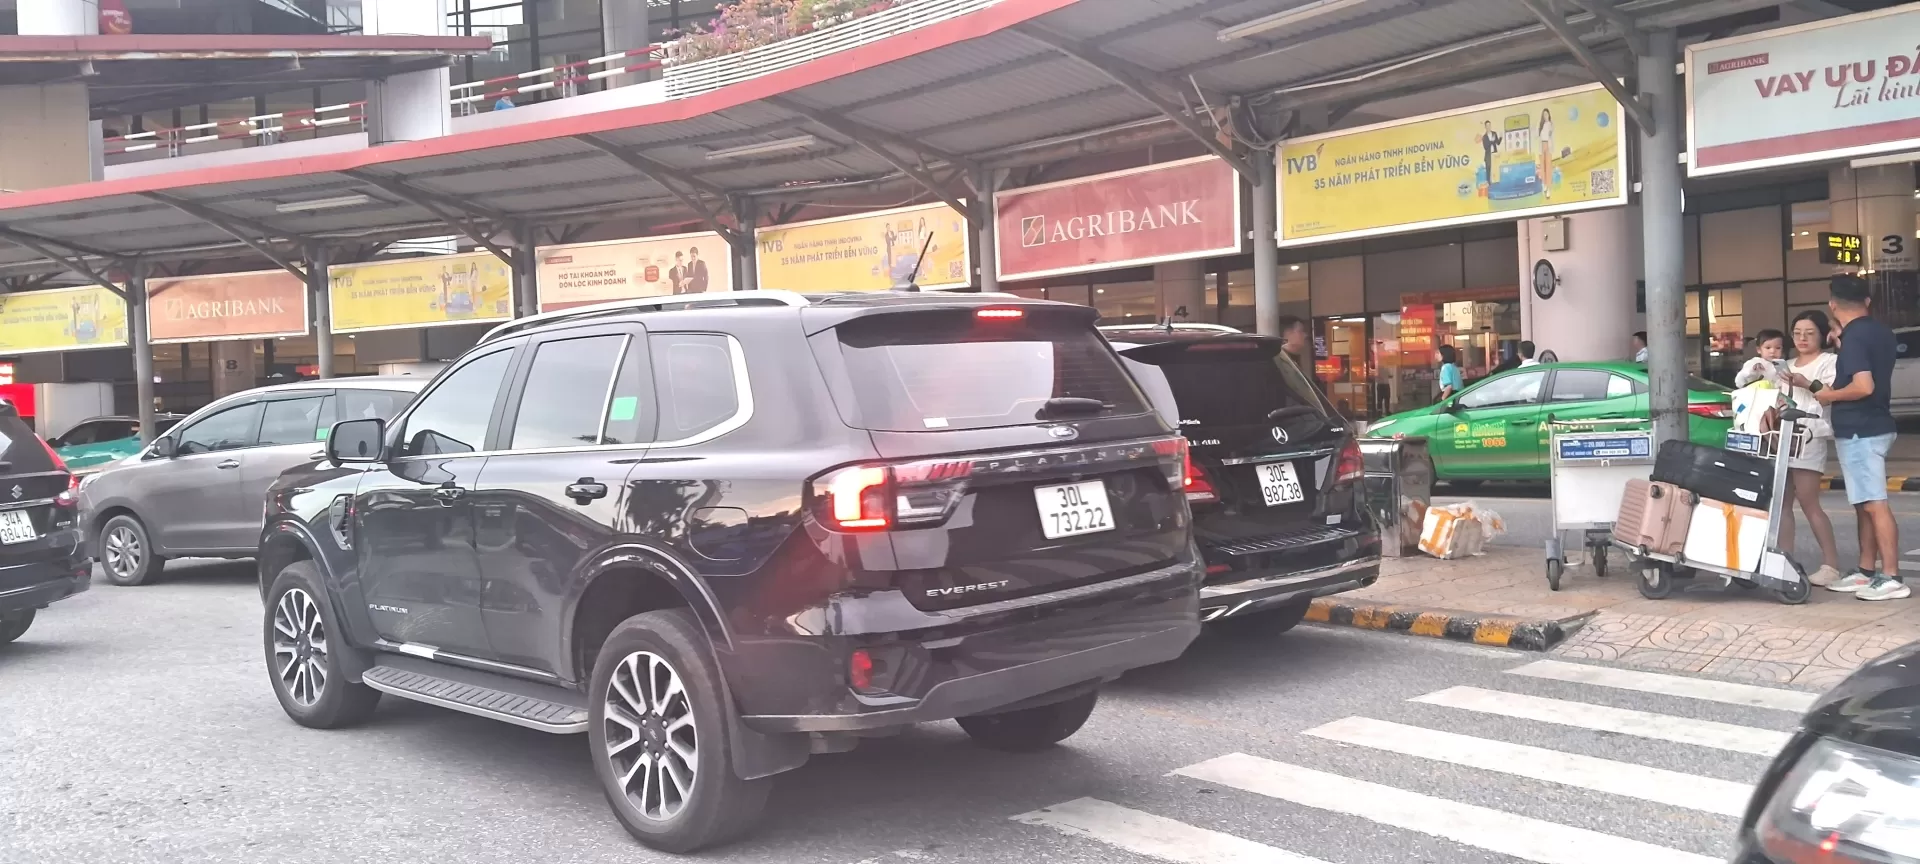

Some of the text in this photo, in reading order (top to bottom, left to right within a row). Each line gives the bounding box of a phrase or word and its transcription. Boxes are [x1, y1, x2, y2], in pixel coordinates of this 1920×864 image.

[1719, 56, 1766, 71] AGRIBANK
[1754, 69, 1816, 98] VAY
[1824, 59, 1876, 88] ƯU
[1834, 82, 1871, 109] Lãi
[1287, 154, 1318, 175] IVB
[1335, 140, 1445, 168] NGÂN HÀNG TNHH INDOVINA
[1314, 154, 1470, 190] 35 NĂM PHÁT TRIỂN BỀN VỮNG
[1049, 199, 1203, 243] AGRIBANK
[1881, 234, 1904, 254] 3
[781, 257, 789, 266] 35
[587, 278, 602, 287] KINH
[604, 277, 627, 286] DOANH
[186, 297, 285, 319] AGRIBANK
[1174, 304, 1190, 318] 4
[226, 359, 238, 370] 8
[990, 446, 1145, 470] PLATINUM
[1266, 463, 1289, 484] 30E
[1056, 485, 1089, 508] 30L
[1264, 483, 1302, 504] 982.38
[2, 512, 23, 526] 34A
[1050, 507, 1107, 533] 732.22
[926, 579, 1010, 598] EVEREST
[369, 603, 409, 614] PLATINUM
